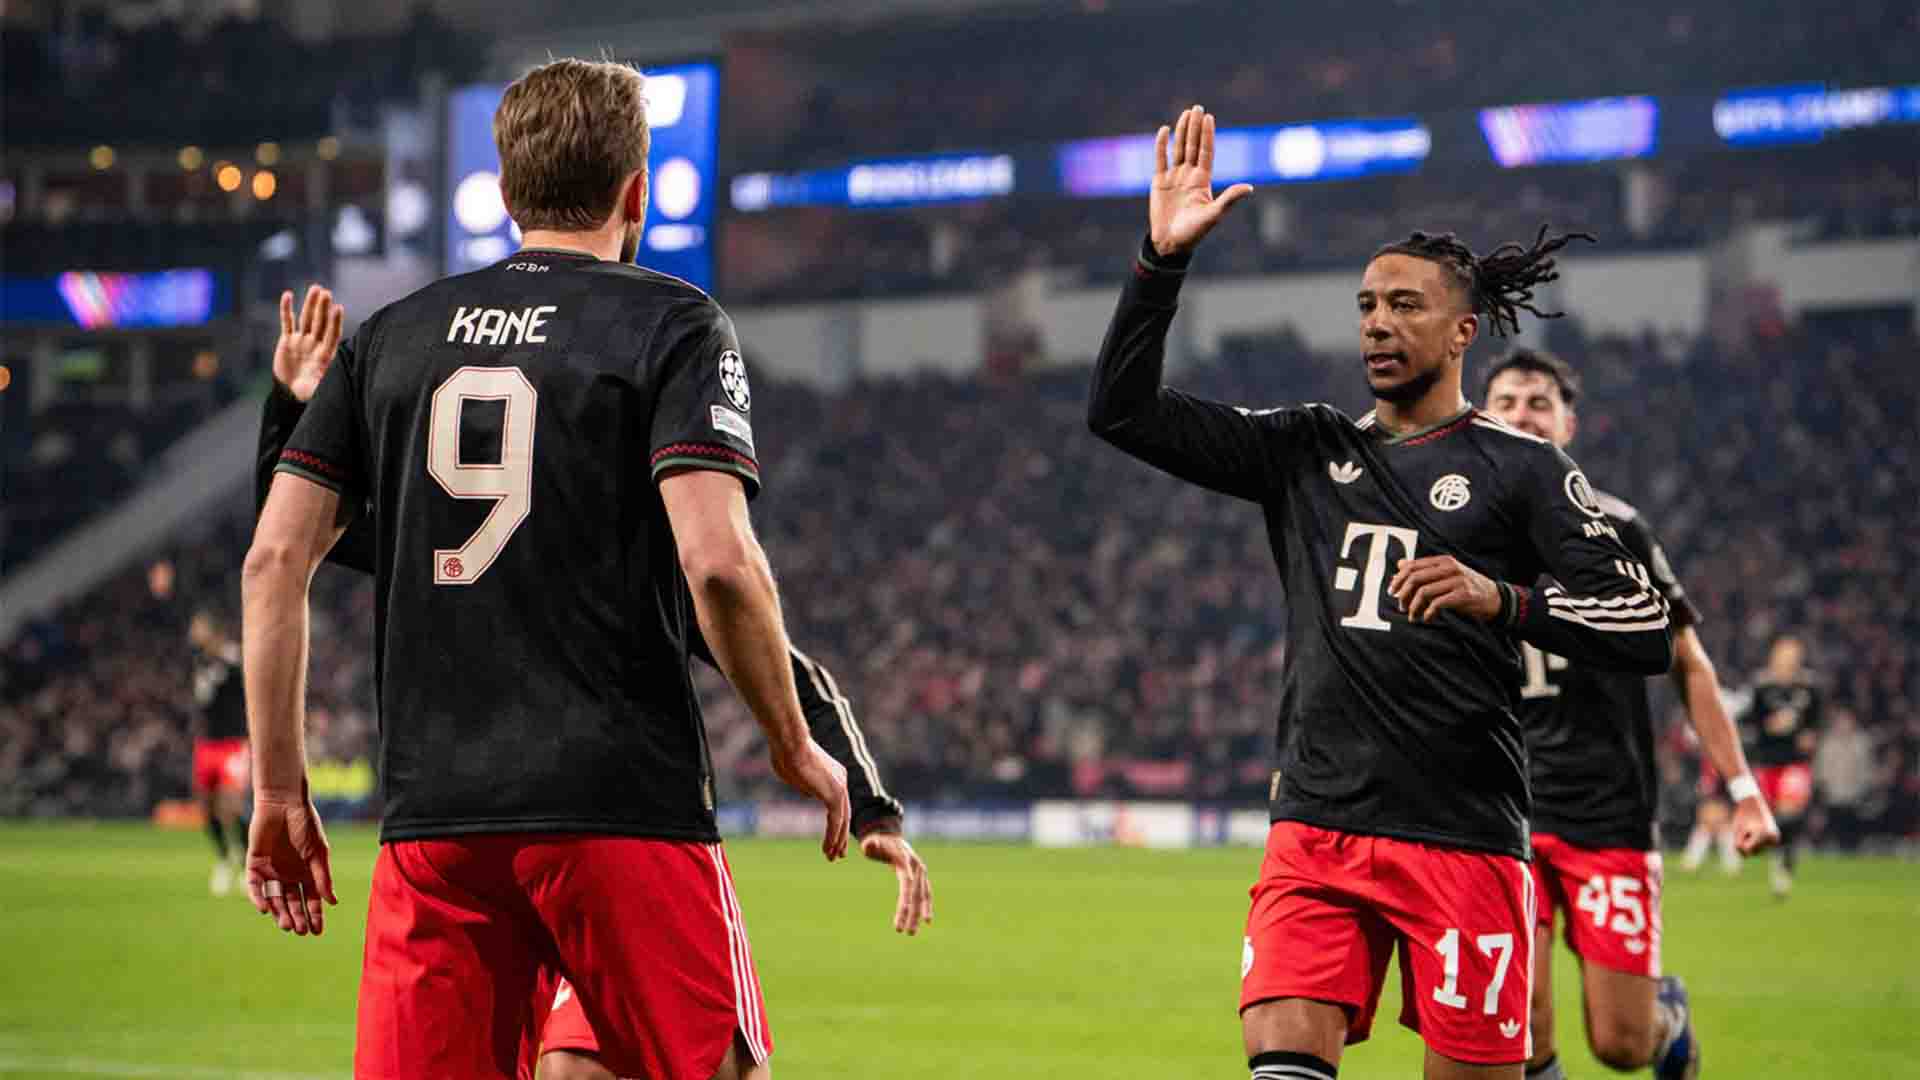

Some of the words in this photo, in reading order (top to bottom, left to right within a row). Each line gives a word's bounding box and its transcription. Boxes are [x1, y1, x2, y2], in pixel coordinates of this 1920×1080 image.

[446, 305, 558, 346] KANE
[426, 365, 538, 585] 9
[1334, 521, 1420, 632] T
[1577, 875, 1645, 936] 45
[1432, 927, 1513, 1016] 17
